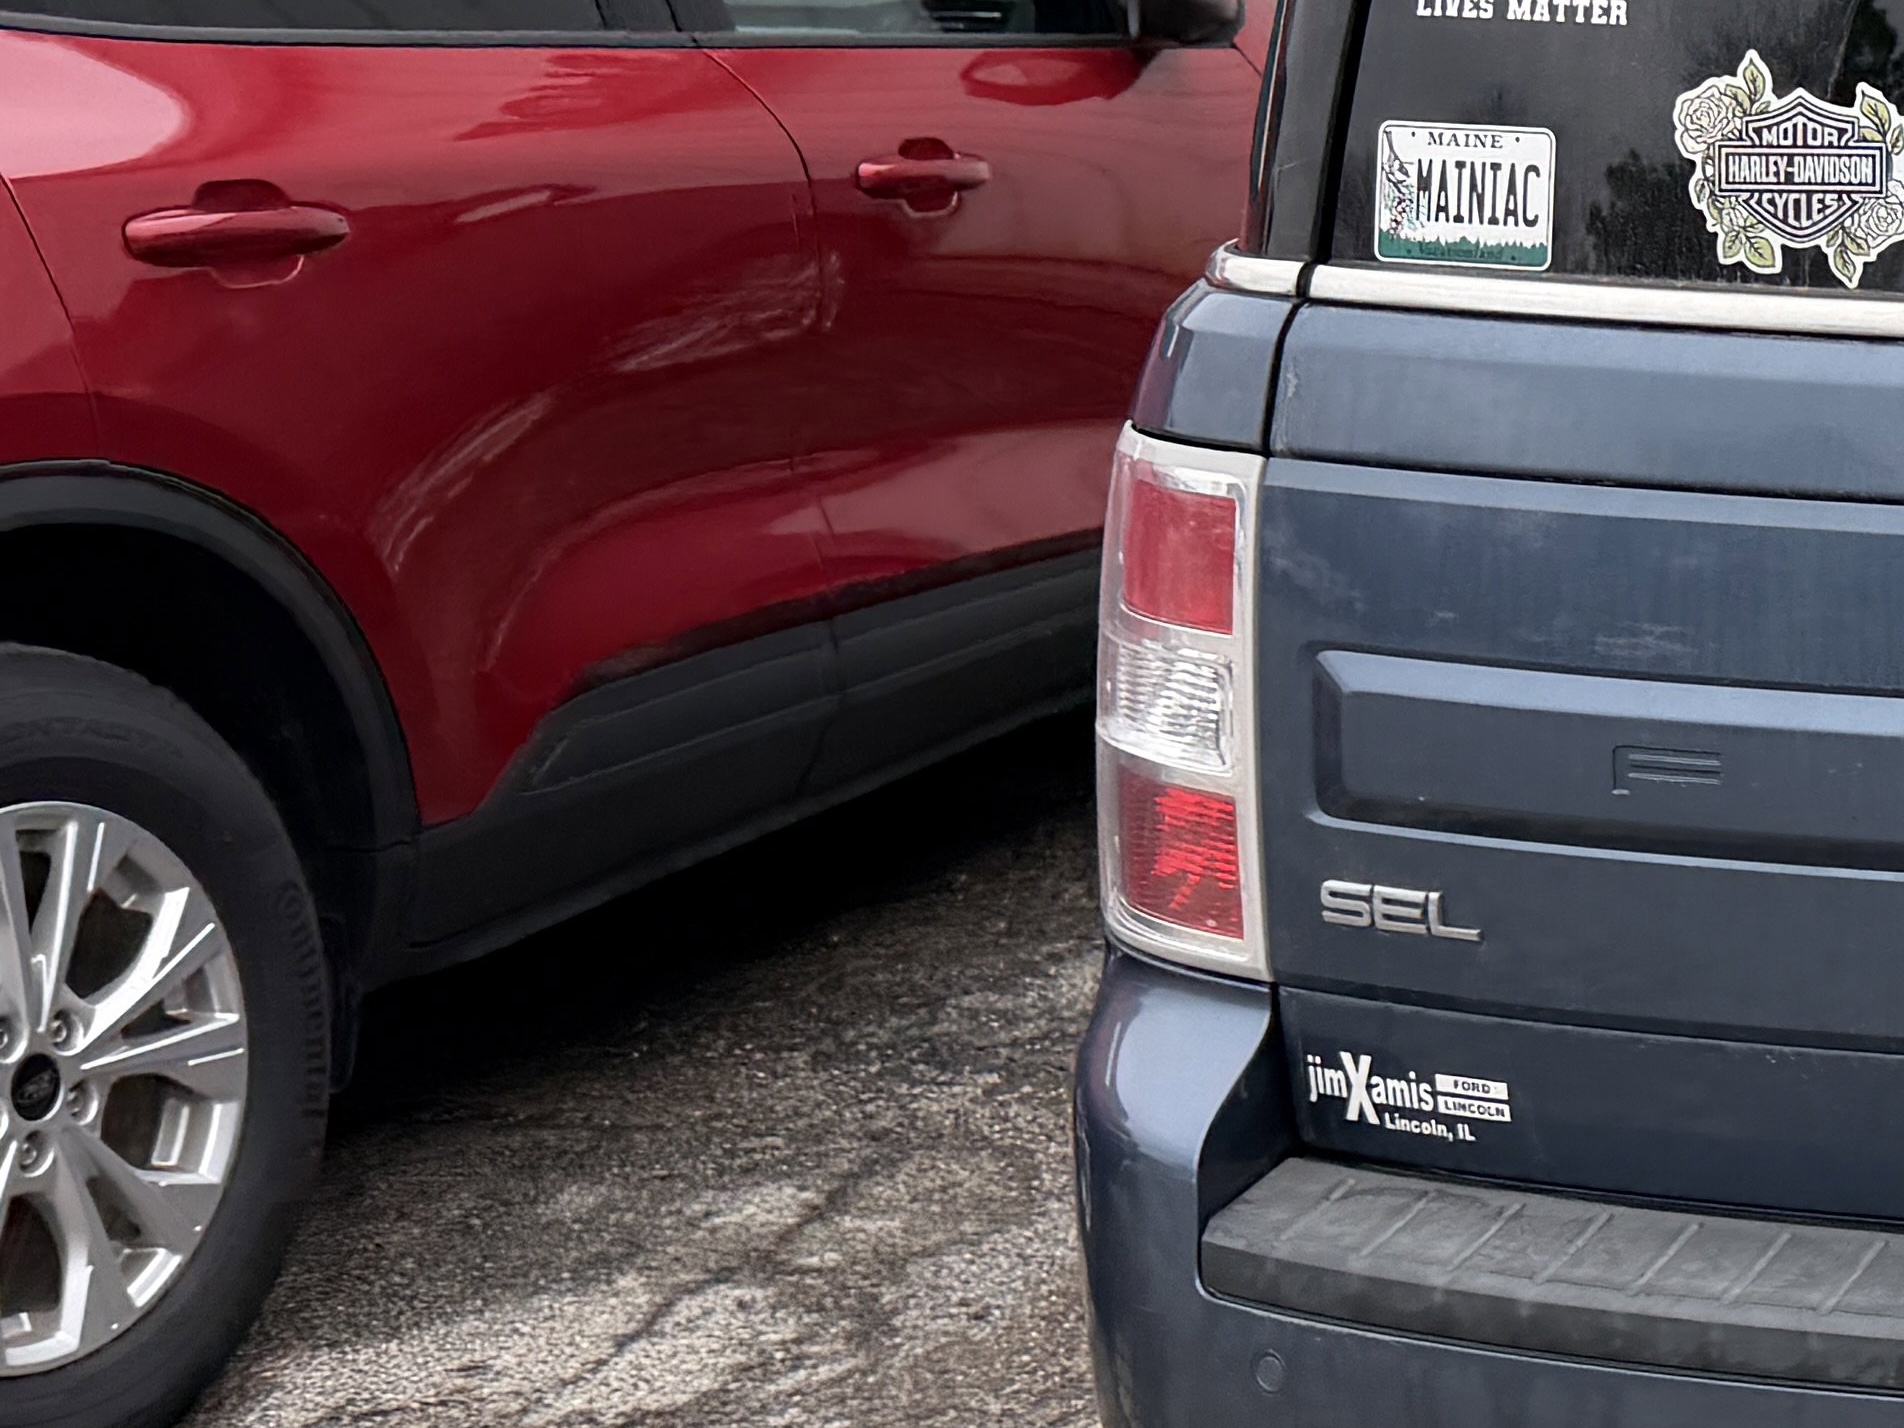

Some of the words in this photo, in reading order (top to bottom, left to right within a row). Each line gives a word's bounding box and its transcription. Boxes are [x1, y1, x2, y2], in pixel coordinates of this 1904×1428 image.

[1428, 131, 1503, 149] MAINE
[1762, 118, 1839, 146] MOTOR
[1728, 155, 1873, 184] HARLEY-DAVIDSON
[1416, 158, 1541, 228] MAINIAC
[1761, 193, 1839, 227] CYCLES
[1321, 880, 1482, 941] SEL
[1453, 1079, 1491, 1094] FORD
[1444, 1099, 1505, 1118] LINCOLN
[1384, 1112, 1453, 1142] Lincoln,
[1457, 1123, 1476, 1141] IL
